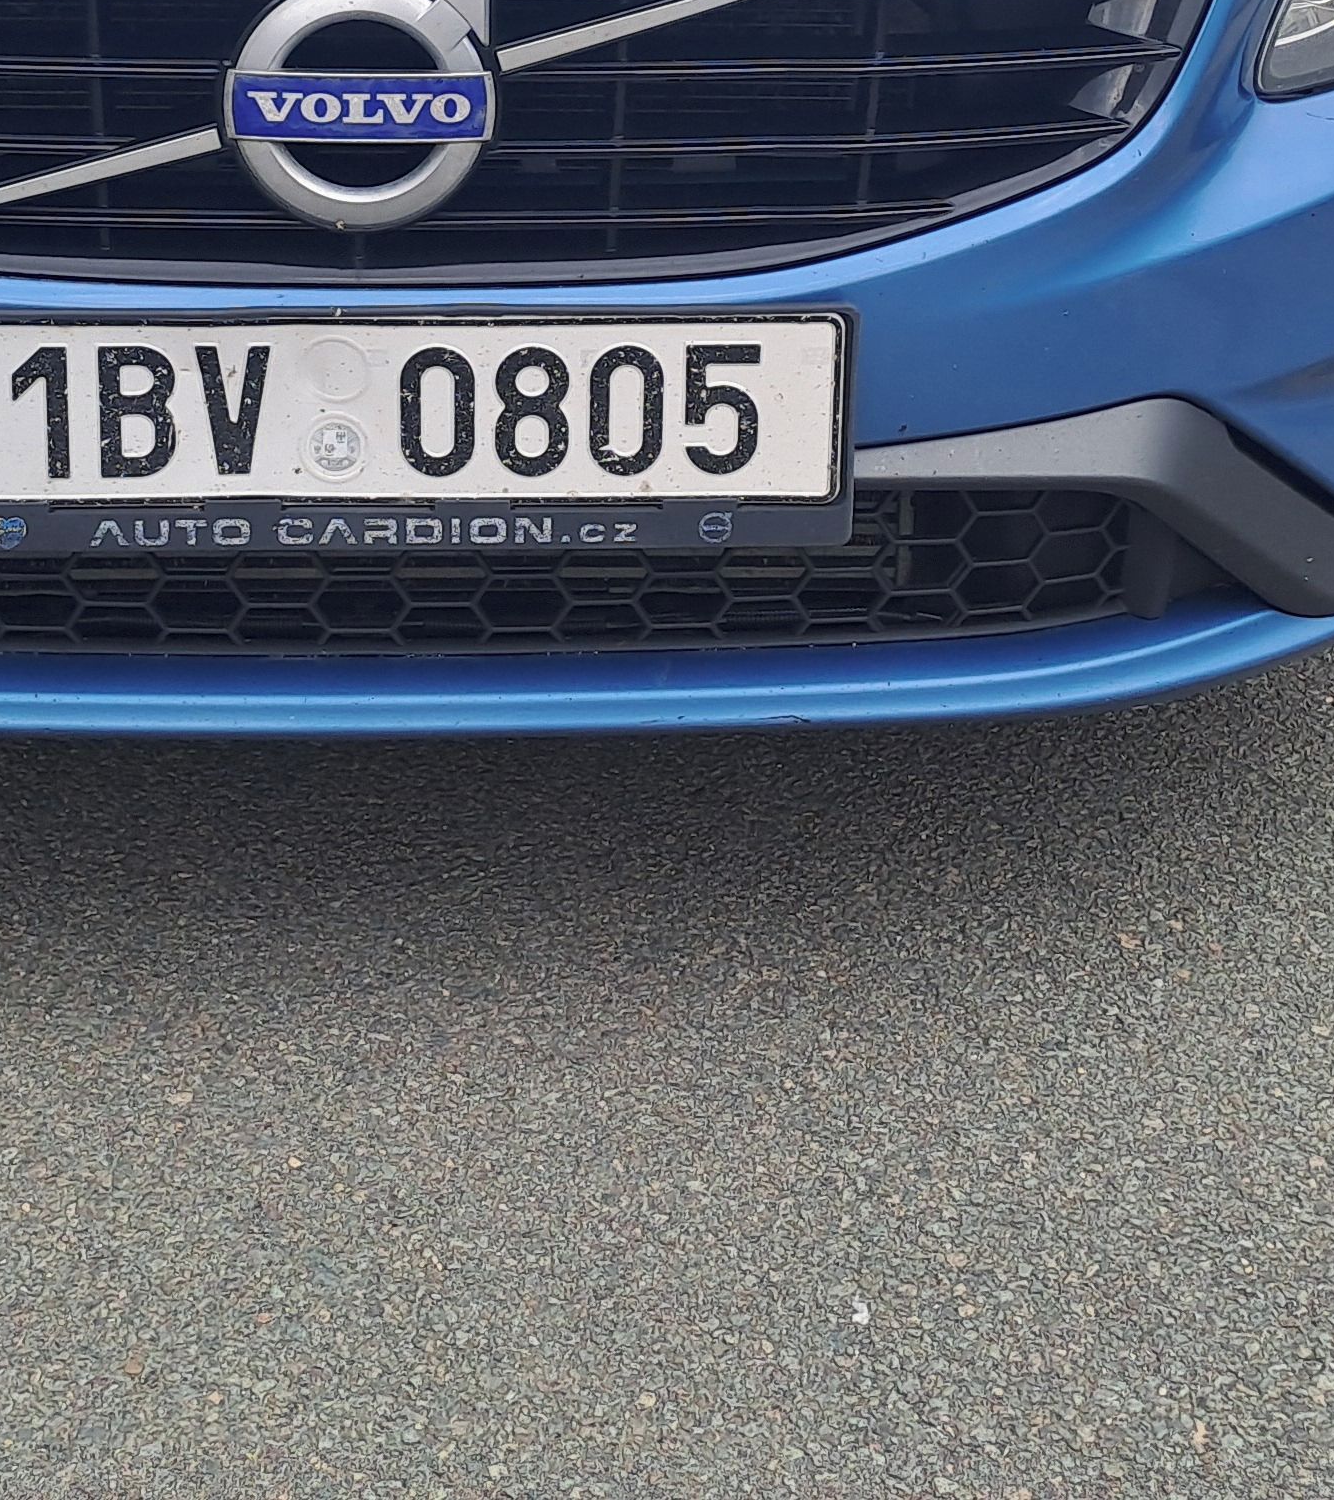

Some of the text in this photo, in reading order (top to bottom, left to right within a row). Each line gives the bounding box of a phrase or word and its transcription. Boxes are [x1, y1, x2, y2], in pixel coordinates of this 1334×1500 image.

[246, 90, 472, 125] VOLVO
[10, 343, 762, 479] 1BV 0805
[89, 516, 638, 547] AUTO CARDION.cz
